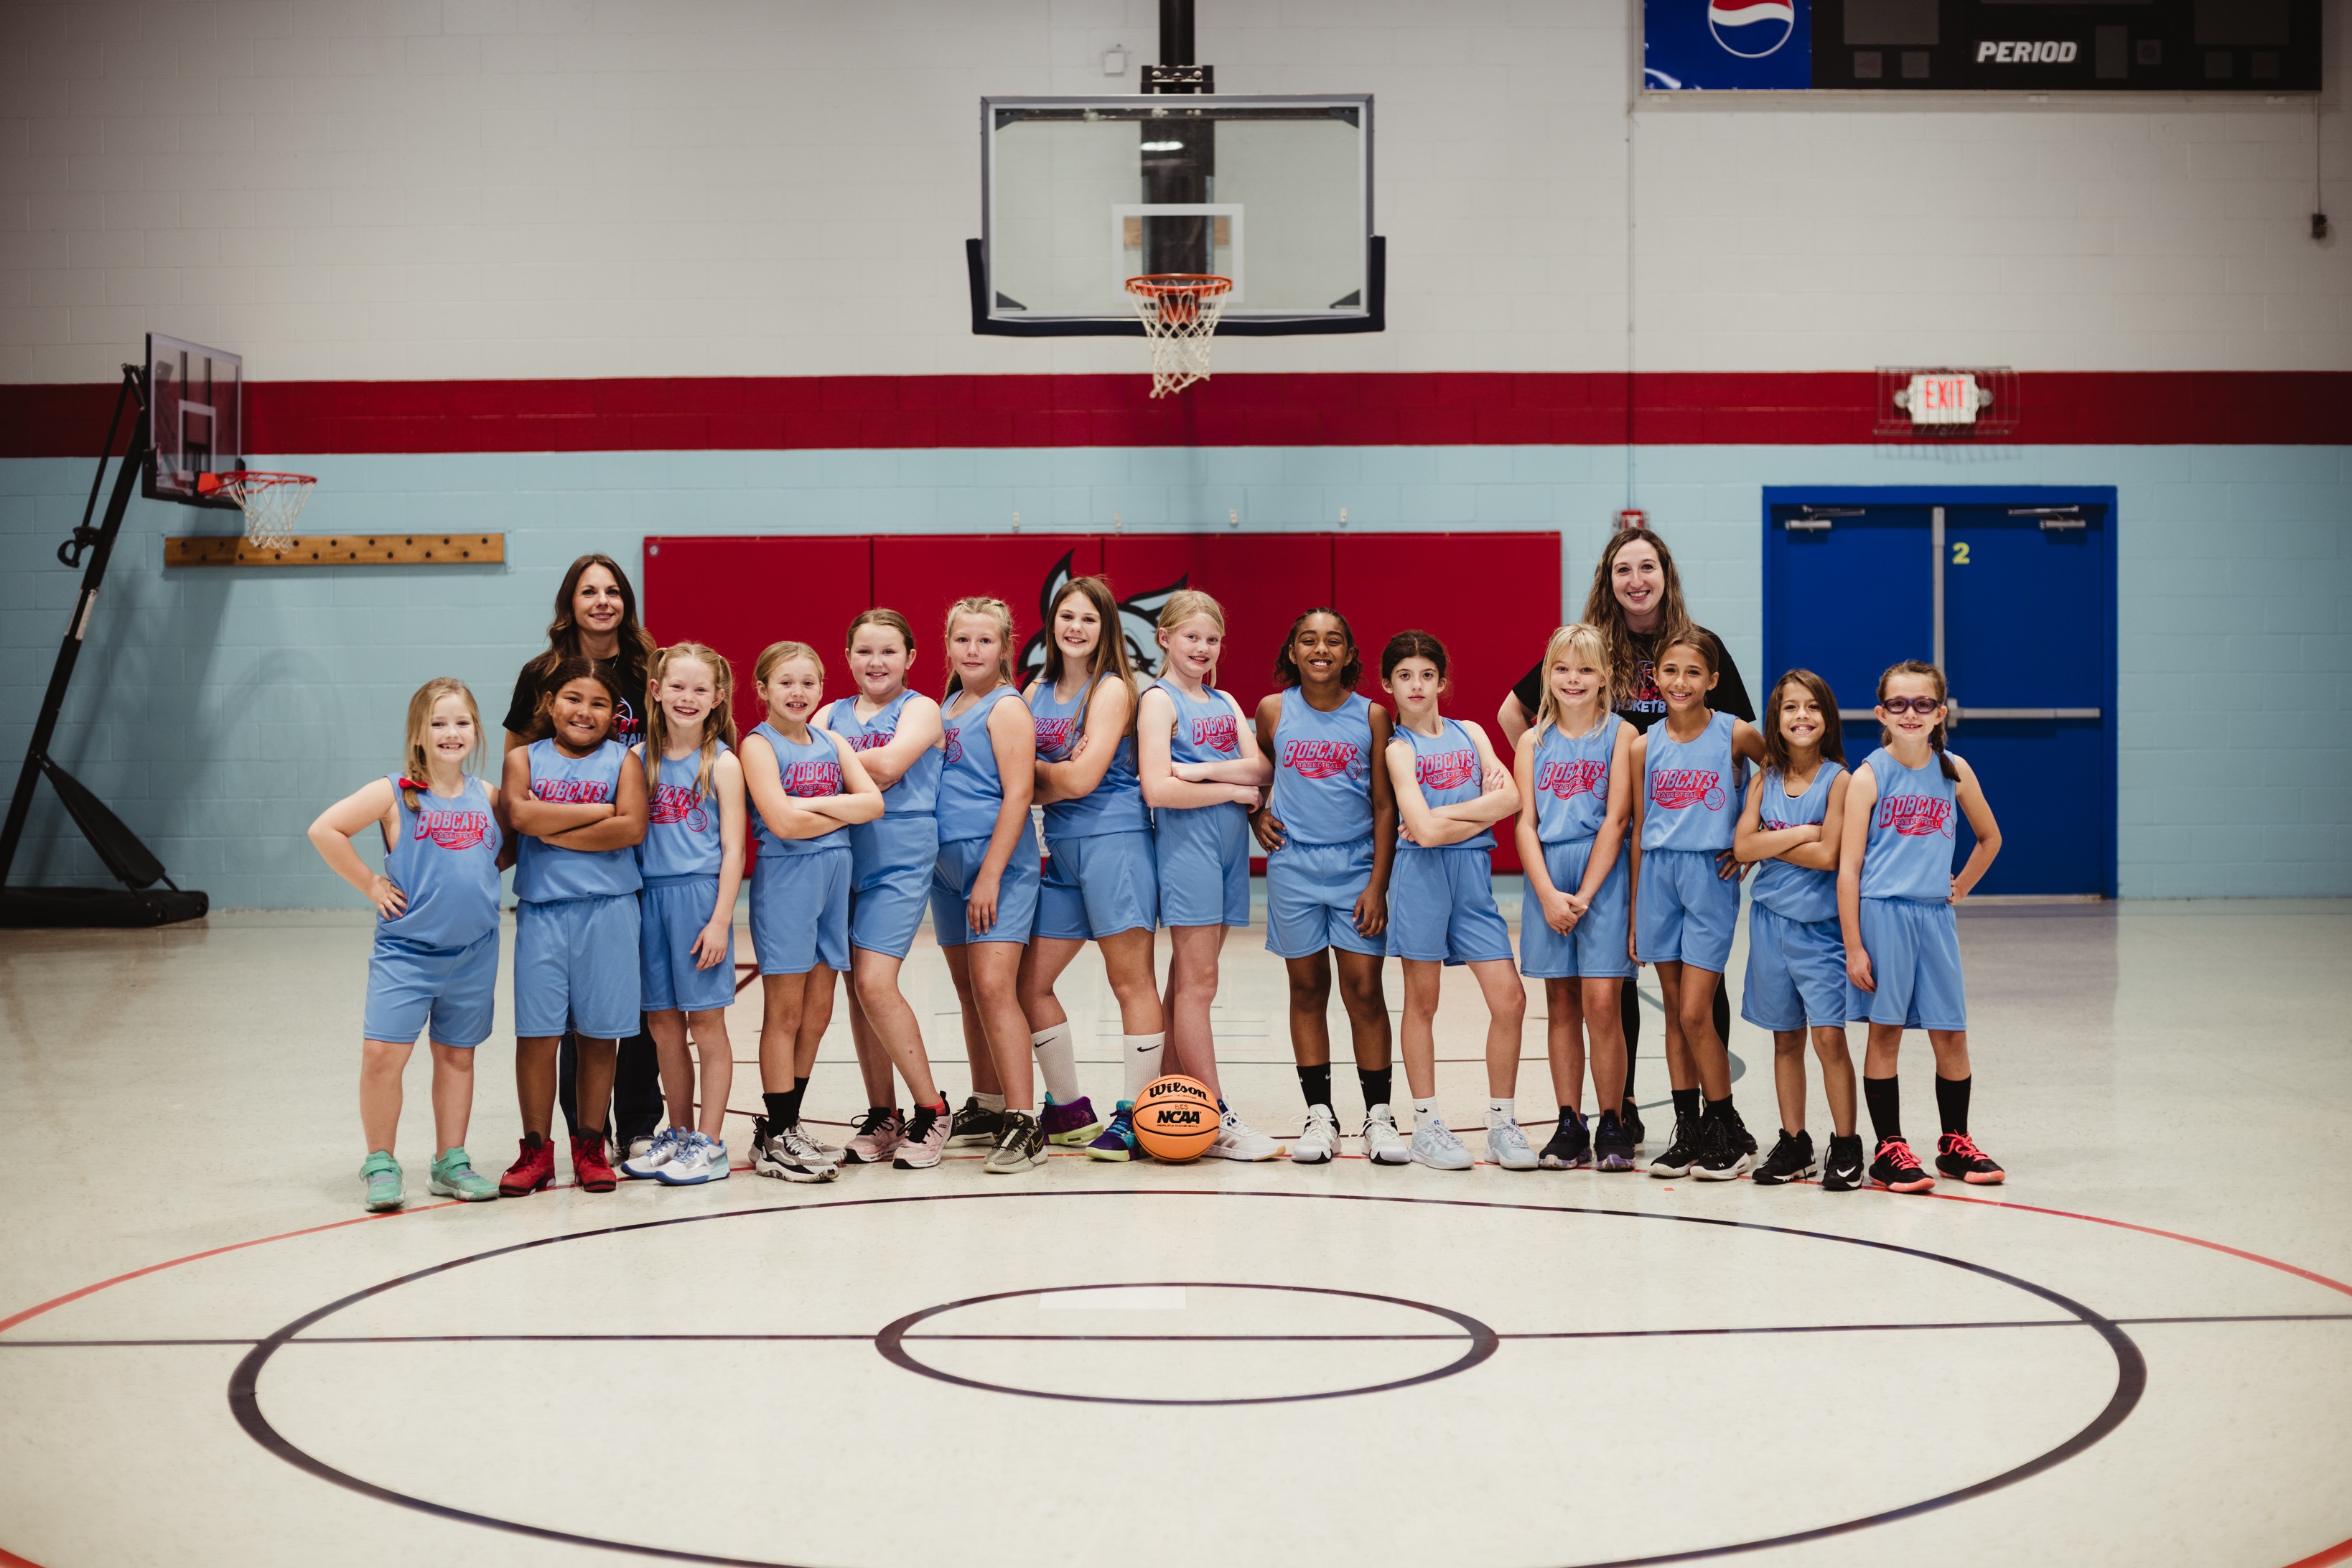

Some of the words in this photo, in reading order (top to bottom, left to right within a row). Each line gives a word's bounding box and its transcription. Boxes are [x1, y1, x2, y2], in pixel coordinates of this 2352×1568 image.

[1977, 41, 2078, 62] PERIOD
[1926, 379, 1966, 409] EXIT
[1952, 541, 1970, 565] 2
[1283, 739, 1358, 768] BOBCATS
[1416, 749, 1475, 785] BOBCATS
[1427, 770, 1470, 783] BASKETBALL
[1879, 795, 1951, 829] BOBCATS
[1895, 818, 1940, 828] BASKETBALL
[414, 810, 488, 841] BOBCATS
[1149, 1082, 1209, 1102] Wilson
[1157, 1110, 1200, 1124] NCAA
